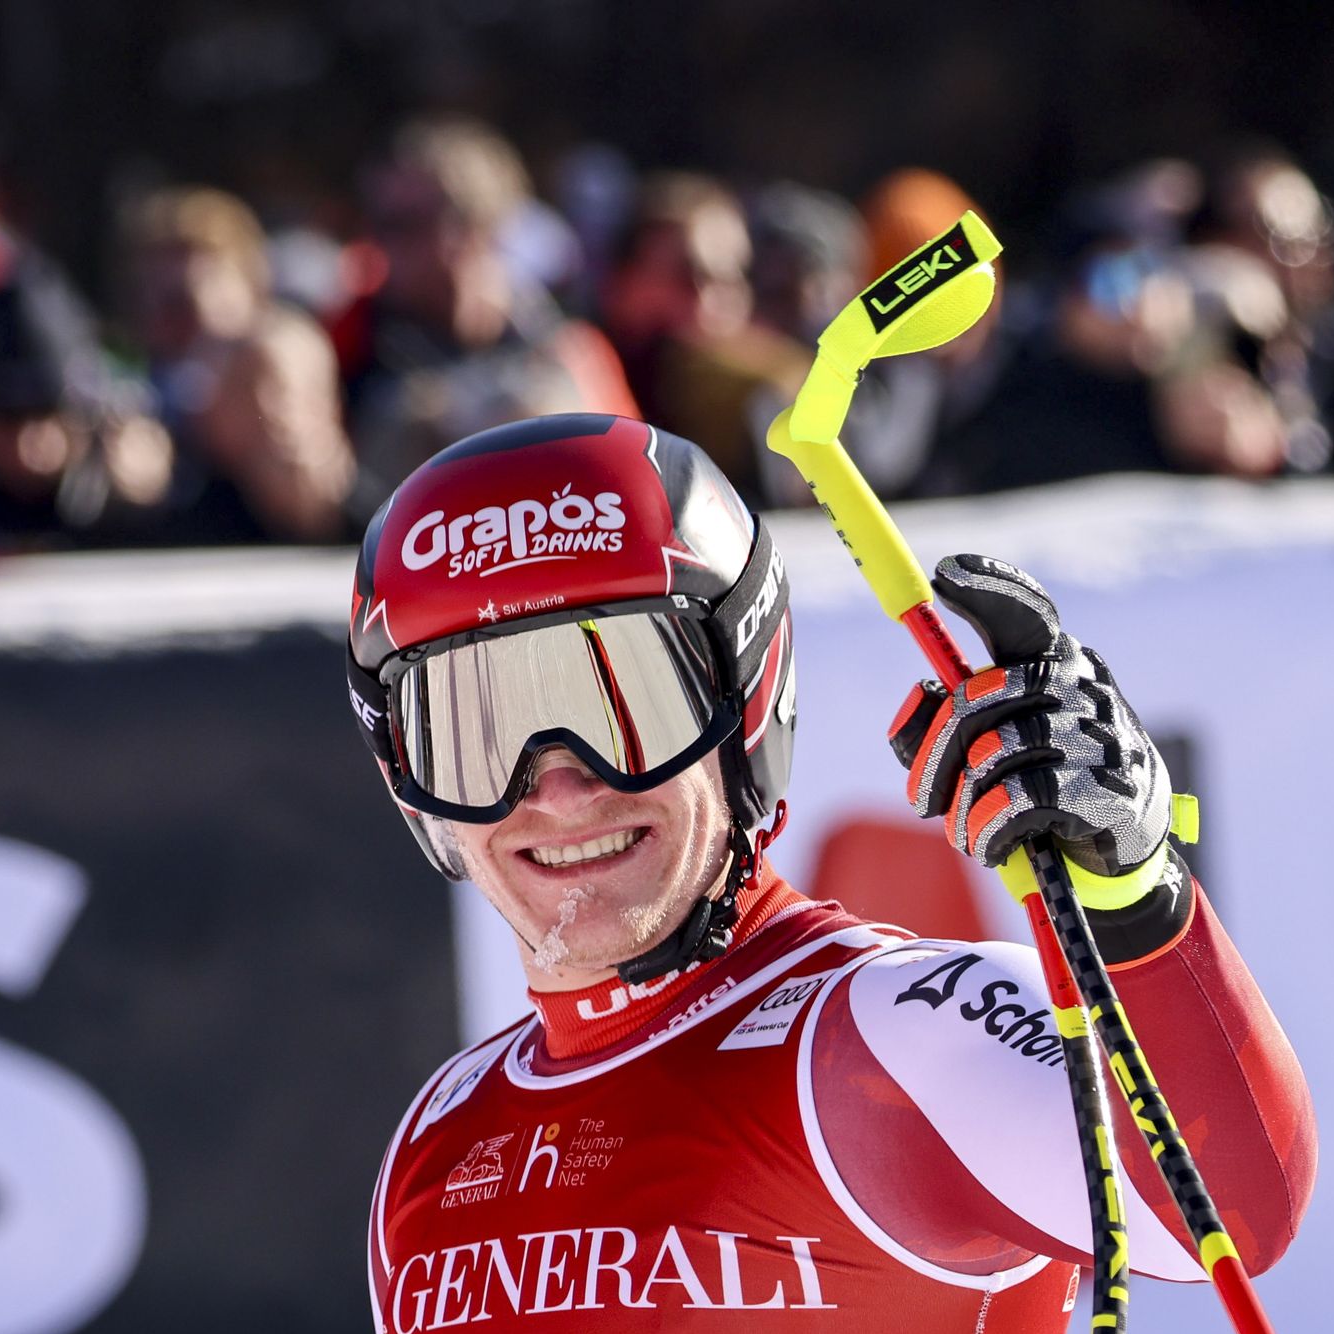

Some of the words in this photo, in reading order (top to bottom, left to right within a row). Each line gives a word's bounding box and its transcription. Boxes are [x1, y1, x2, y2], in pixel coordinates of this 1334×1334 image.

[870, 245, 962, 315] LEKI
[448, 540, 508, 579] SOFT
[529, 522, 623, 556] DRINKS
[502, 604, 521, 616] Ski
[524, 594, 566, 613] Austria
[777, 1021, 789, 1029] Cup
[578, 1118, 605, 1133] The
[569, 1135, 624, 1151] Human
[563, 1152, 613, 1171] Safety
[558, 1170, 586, 1187] Net
[441, 1182, 501, 1209] GENERALI
